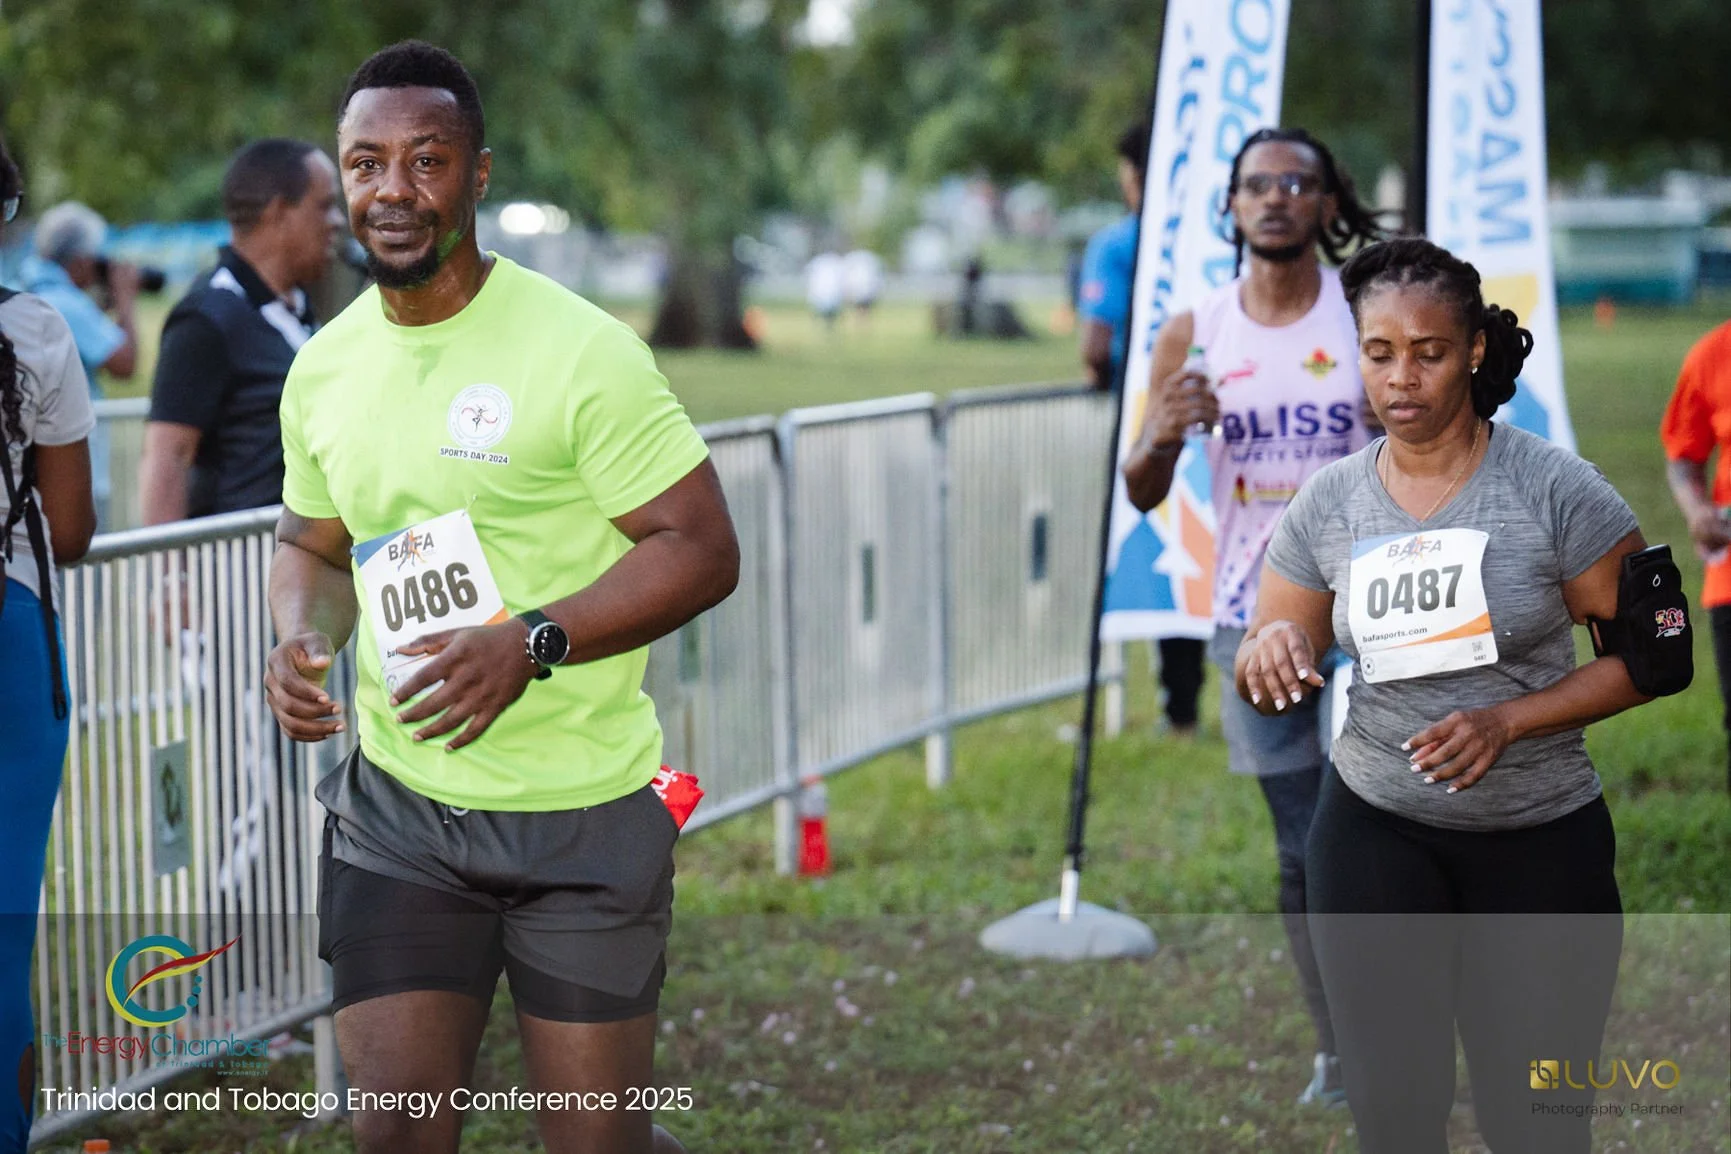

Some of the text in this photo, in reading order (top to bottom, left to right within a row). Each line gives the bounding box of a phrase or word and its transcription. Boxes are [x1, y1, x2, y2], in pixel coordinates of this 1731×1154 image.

[1223, 401, 1354, 443] BLISS
[440, 447, 508, 464] SPORTS DAY 2024
[388, 531, 435, 561] BAFA
[1387, 539, 1442, 558] BAFA
[381, 562, 478, 632] 0486
[1366, 564, 1463, 620] 0487
[1362, 626, 1428, 643] bafasports.com
